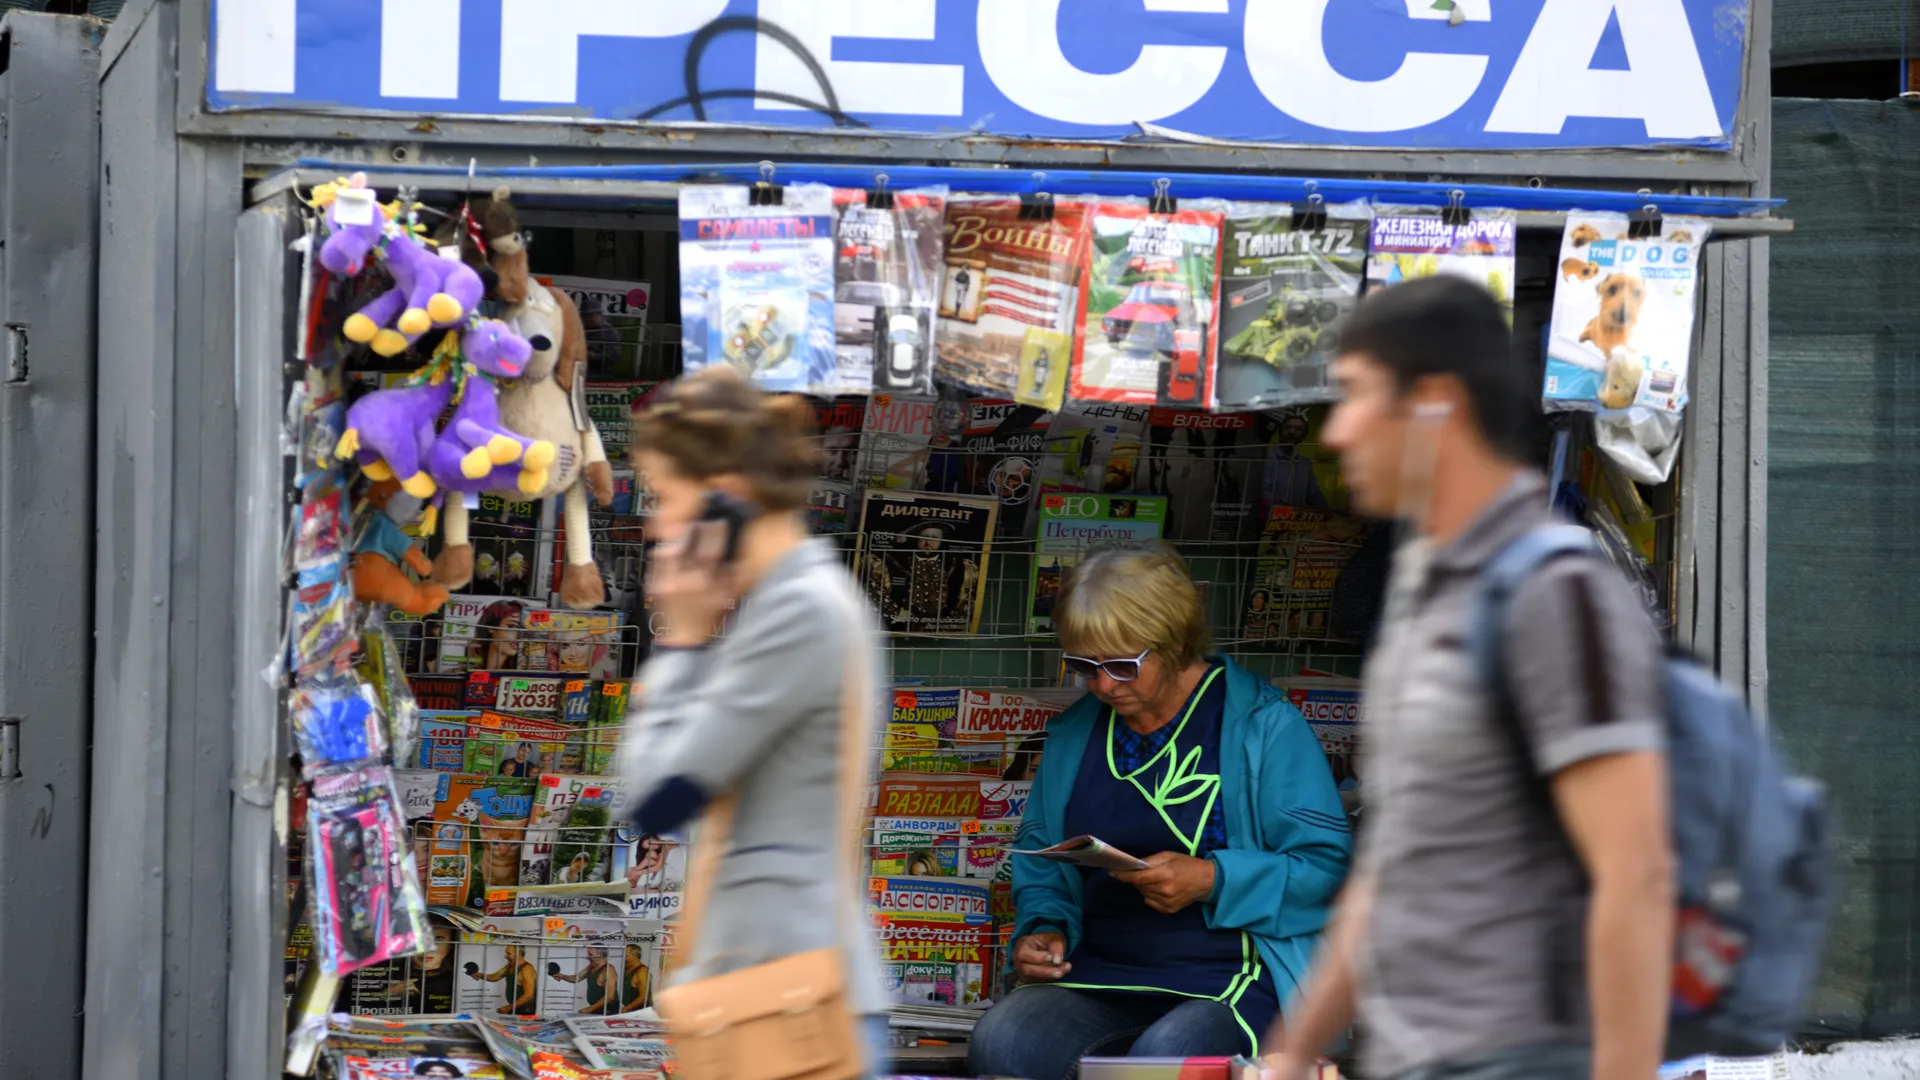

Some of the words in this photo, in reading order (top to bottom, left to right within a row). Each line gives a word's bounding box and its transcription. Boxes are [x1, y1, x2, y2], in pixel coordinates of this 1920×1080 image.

[214, 0, 1724, 140] ПРЕССА
[697, 216, 815, 239] САМОЛЕТЫ
[1375, 217, 1453, 236] ЖЕЛЕЗНАЯ
[1455, 221, 1513, 240] ДОРОГА
[1234, 231, 1296, 257] ТАНК
[1295, 228, 1354, 254] Т-72
[1374, 234, 1382, 246] В
[1384, 235, 1452, 248] МИНИАТЮРЕ
[1590, 247, 1615, 259] THE
[1620, 244, 1689, 265] DOG
[865, 402, 934, 435] SHAPE
[1006, 434, 1045, 452] ФИФ
[1044, 496, 1100, 518] GEO
[1046, 521, 1136, 544] Петербург
[1000, 695, 1023, 706] 100
[1303, 703, 1360, 720] АССО
[428, 728, 464, 746] 100
[518, 895, 575, 909] ВЯЗАНЫЕ
[629, 895, 680, 910] АРИКОЗ
[881, 892, 987, 913] АССОРТИ
[880, 922, 981, 943] Весёлый
[595, 1046, 676, 1058] АРГУМЕНТ
